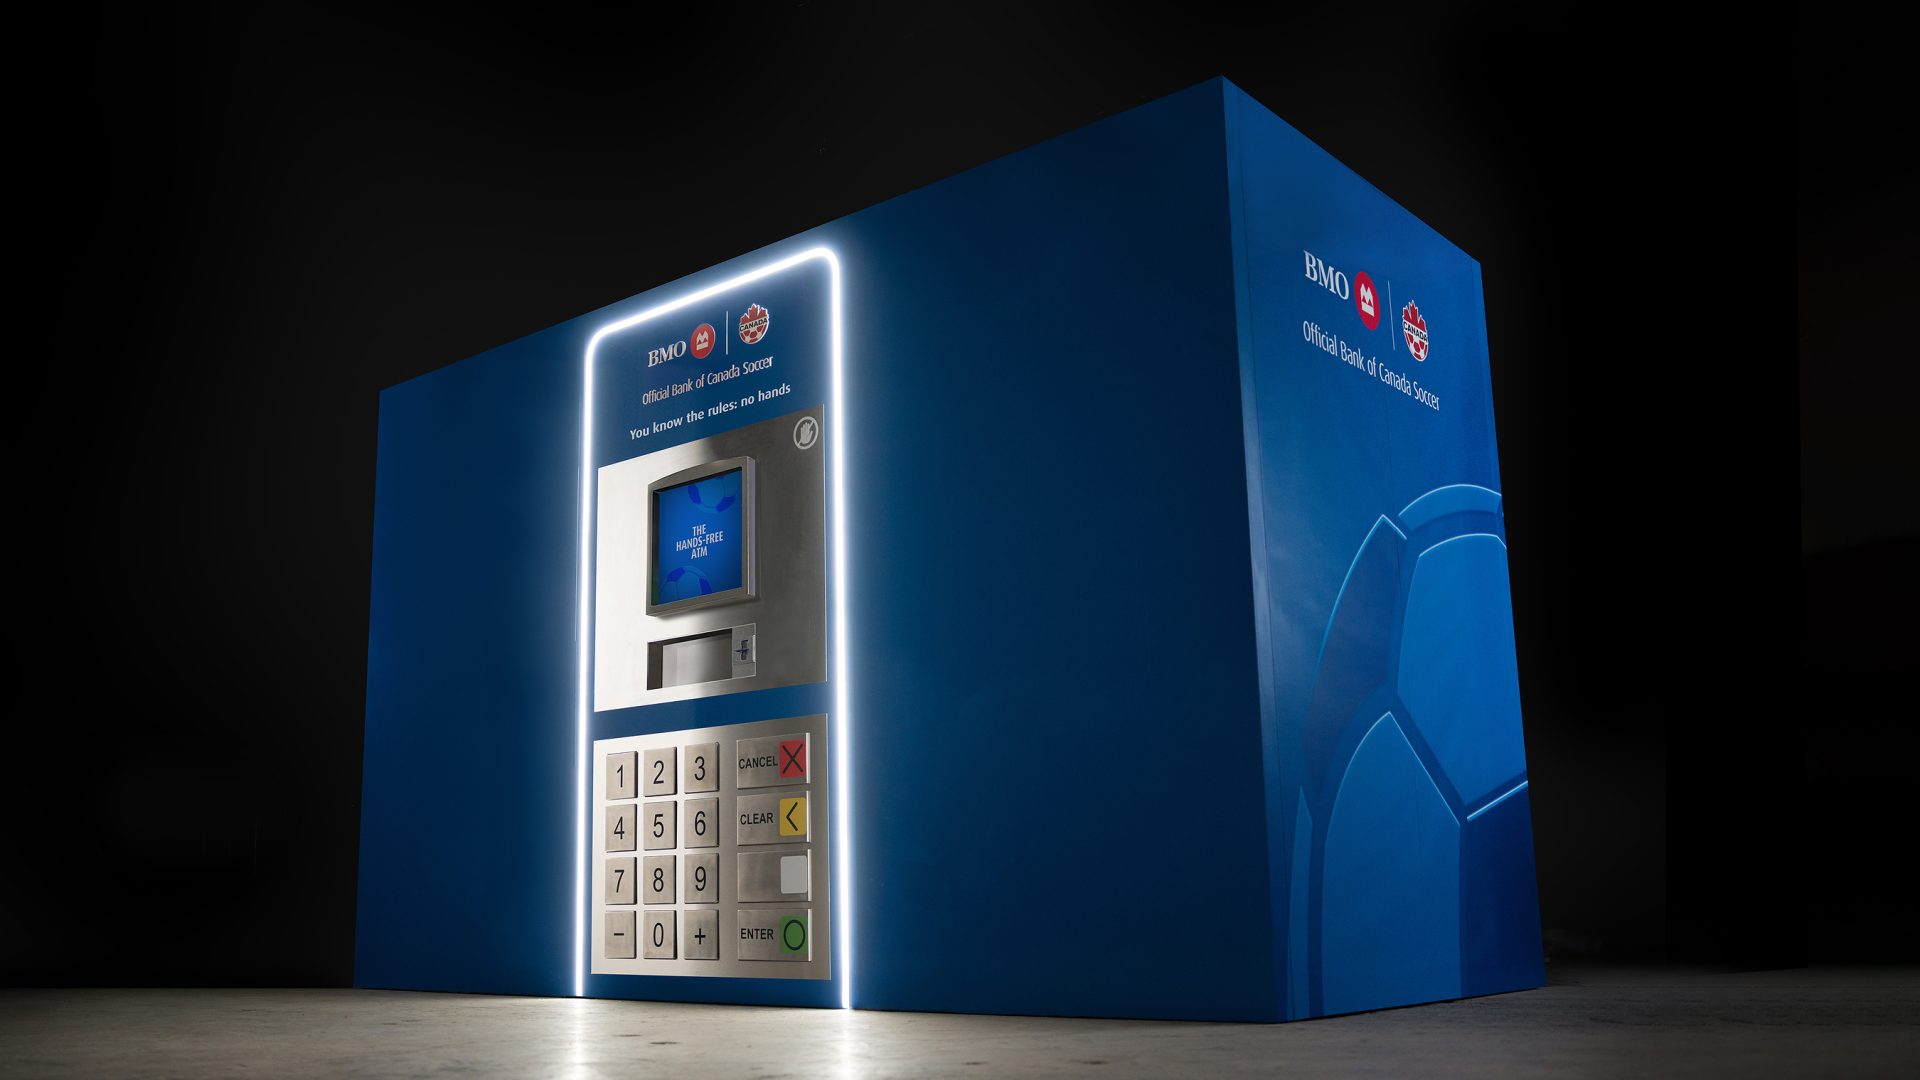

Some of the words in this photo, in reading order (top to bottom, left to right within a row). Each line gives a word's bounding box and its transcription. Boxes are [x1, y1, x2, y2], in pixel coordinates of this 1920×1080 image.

[1304, 250, 1349, 300] BMO
[739, 317, 767, 332] CANADA
[1403, 321, 1428, 342] CANADA
[647, 340, 687, 367] BMO
[1303, 321, 1338, 356] Official
[1340, 341, 1365, 371] Bank
[1367, 357, 1376, 377] of
[1380, 362, 1411, 396] Canada
[1414, 381, 1439, 410] Soccer
[643, 385, 670, 405] Official
[672, 379, 693, 397] Bank
[696, 375, 705, 389] of
[707, 364, 740, 385] Canada
[743, 355, 773, 374] Soccer
[630, 427, 649, 440] You
[653, 417, 683, 433] know
[687, 408, 704, 423] the
[708, 400, 737, 417] rules:
[741, 396, 754, 407] no
[758, 383, 791, 402] hands
[676, 531, 723, 551] HANDS-FREE
[693, 524, 706, 536] THE
[691, 547, 707, 559] ATM
[617, 765, 623, 788] 1
[654, 760, 664, 784] 2
[695, 756, 705, 780] 3
[739, 755, 778, 769] CANCEL
[614, 817, 624, 839] 4
[654, 814, 664, 838] 5
[695, 811, 706, 835] 6
[740, 813, 773, 825] CLEAR
[615, 870, 624, 893] 7
[654, 868, 664, 892] 8
[695, 867, 706, 891] 9
[654, 923, 664, 947] 0
[741, 929, 774, 939] ENTER
